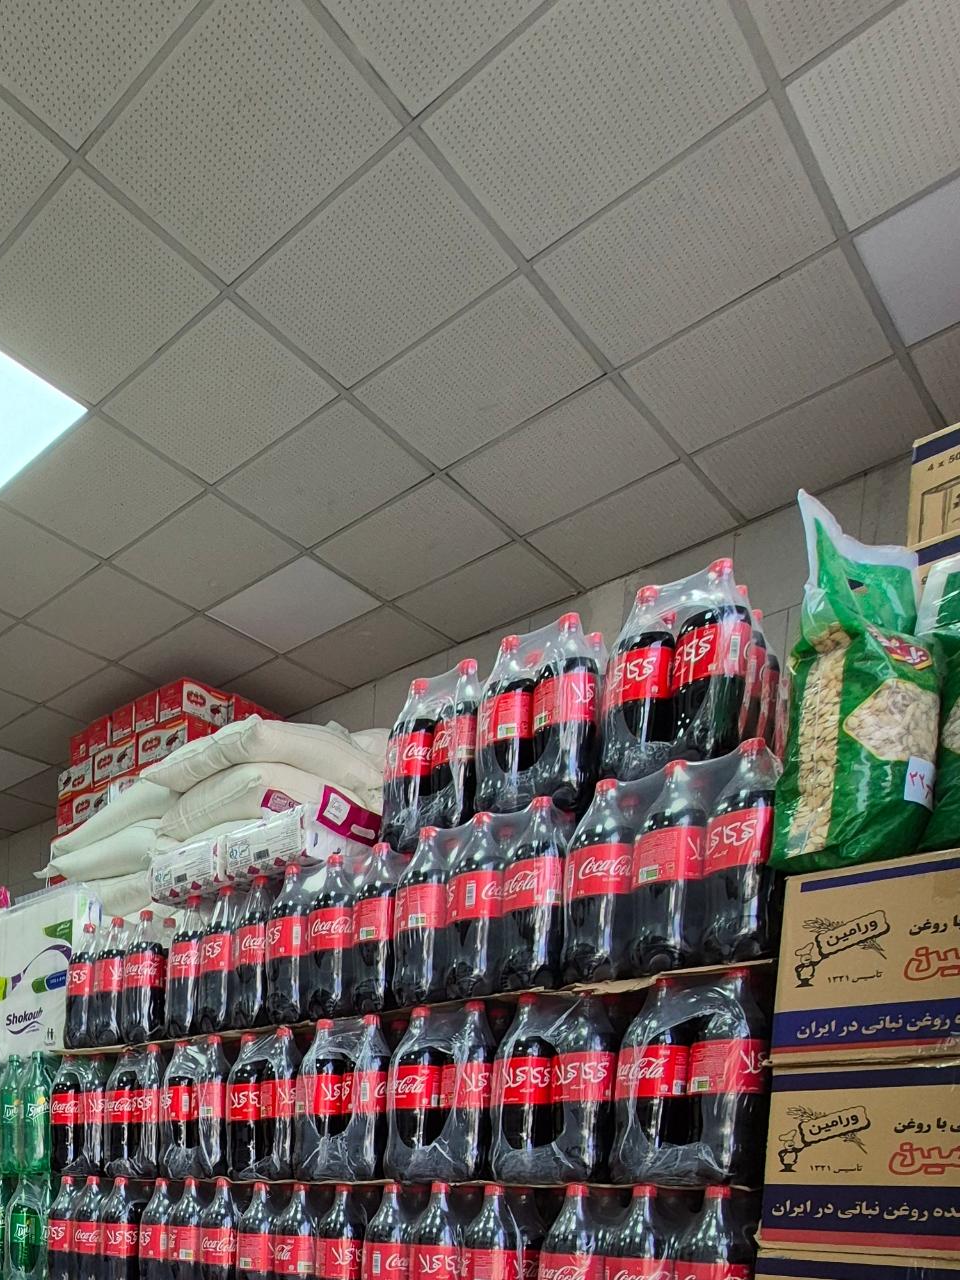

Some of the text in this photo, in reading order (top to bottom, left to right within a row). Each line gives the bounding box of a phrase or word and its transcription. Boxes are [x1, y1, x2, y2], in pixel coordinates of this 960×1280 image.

[826, 919, 878, 947] ورامین
[909, 918, 948, 936] روغن
[796, 1011, 951, 1039] روغن نباتی در ایران
[809, 1113, 859, 1136] ورامین
[894, 1117, 931, 1134] روغن
[771, 1200, 929, 1221] روغن نباتی در ایران
